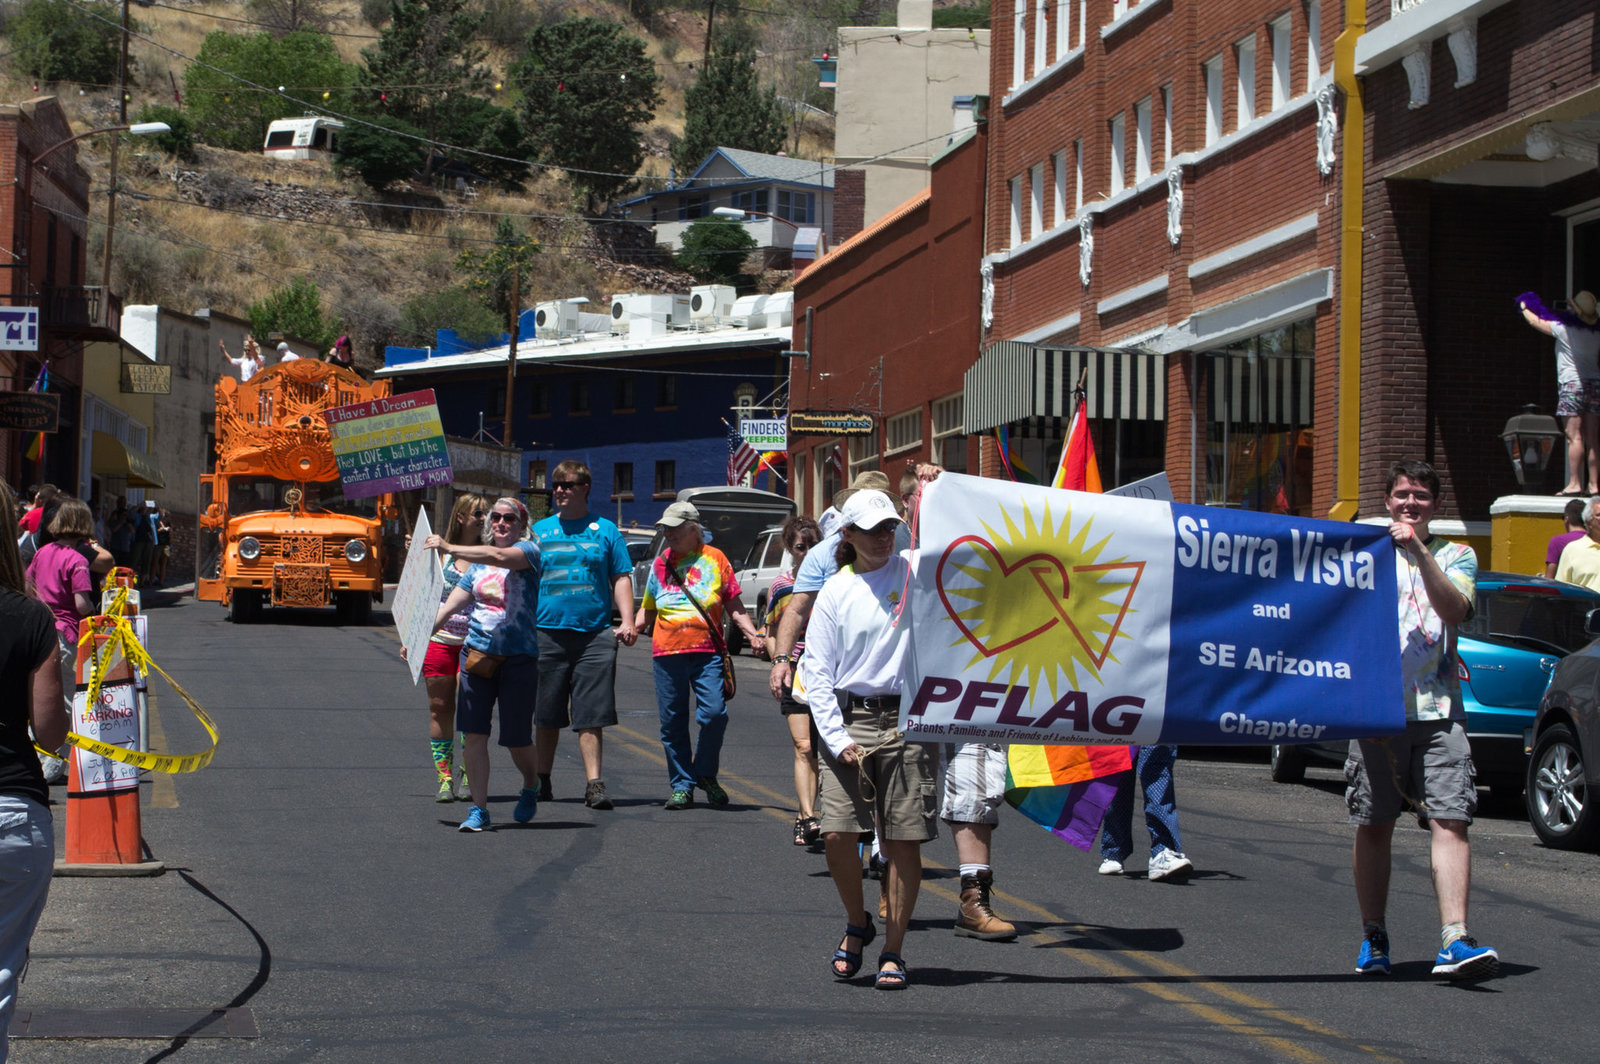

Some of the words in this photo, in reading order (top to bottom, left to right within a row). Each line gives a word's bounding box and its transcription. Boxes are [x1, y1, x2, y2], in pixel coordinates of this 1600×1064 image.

[329, 410, 337, 422] I
[338, 408, 366, 420] Have
[371, 402, 379, 415] A
[742, 422, 786, 435] FINDERS
[823, 418, 871, 430] morphosis
[336, 455, 355, 469] they
[391, 444, 405, 459] but
[407, 443, 420, 456] by
[420, 439, 439, 453] the
[342, 466, 370, 484] content
[374, 464, 382, 479] of
[384, 462, 404, 477] their
[428, 469, 449, 483] MOM
[1177, 515, 1278, 579] Sierra
[1290, 528, 1375, 590] Vista
[1253, 603, 1291, 620] and
[1198, 641, 1236, 668] SE
[1244, 647, 1351, 679] Arizona
[96, 693, 114, 704] NO
[908, 676, 1146, 735] PFLAG
[81, 707, 133, 724] PARKING
[1219, 711, 1327, 740] Chapter
[906, 719, 946, 735] Parents,
[947, 723, 986, 737] Families
[988, 728, 1004, 738] and
[1007, 729, 1041, 741] Friends
[1042, 732, 1054, 741] of
[1054, 734, 1094, 743] Lesbians
[88, 758, 117, 768] JUNE
